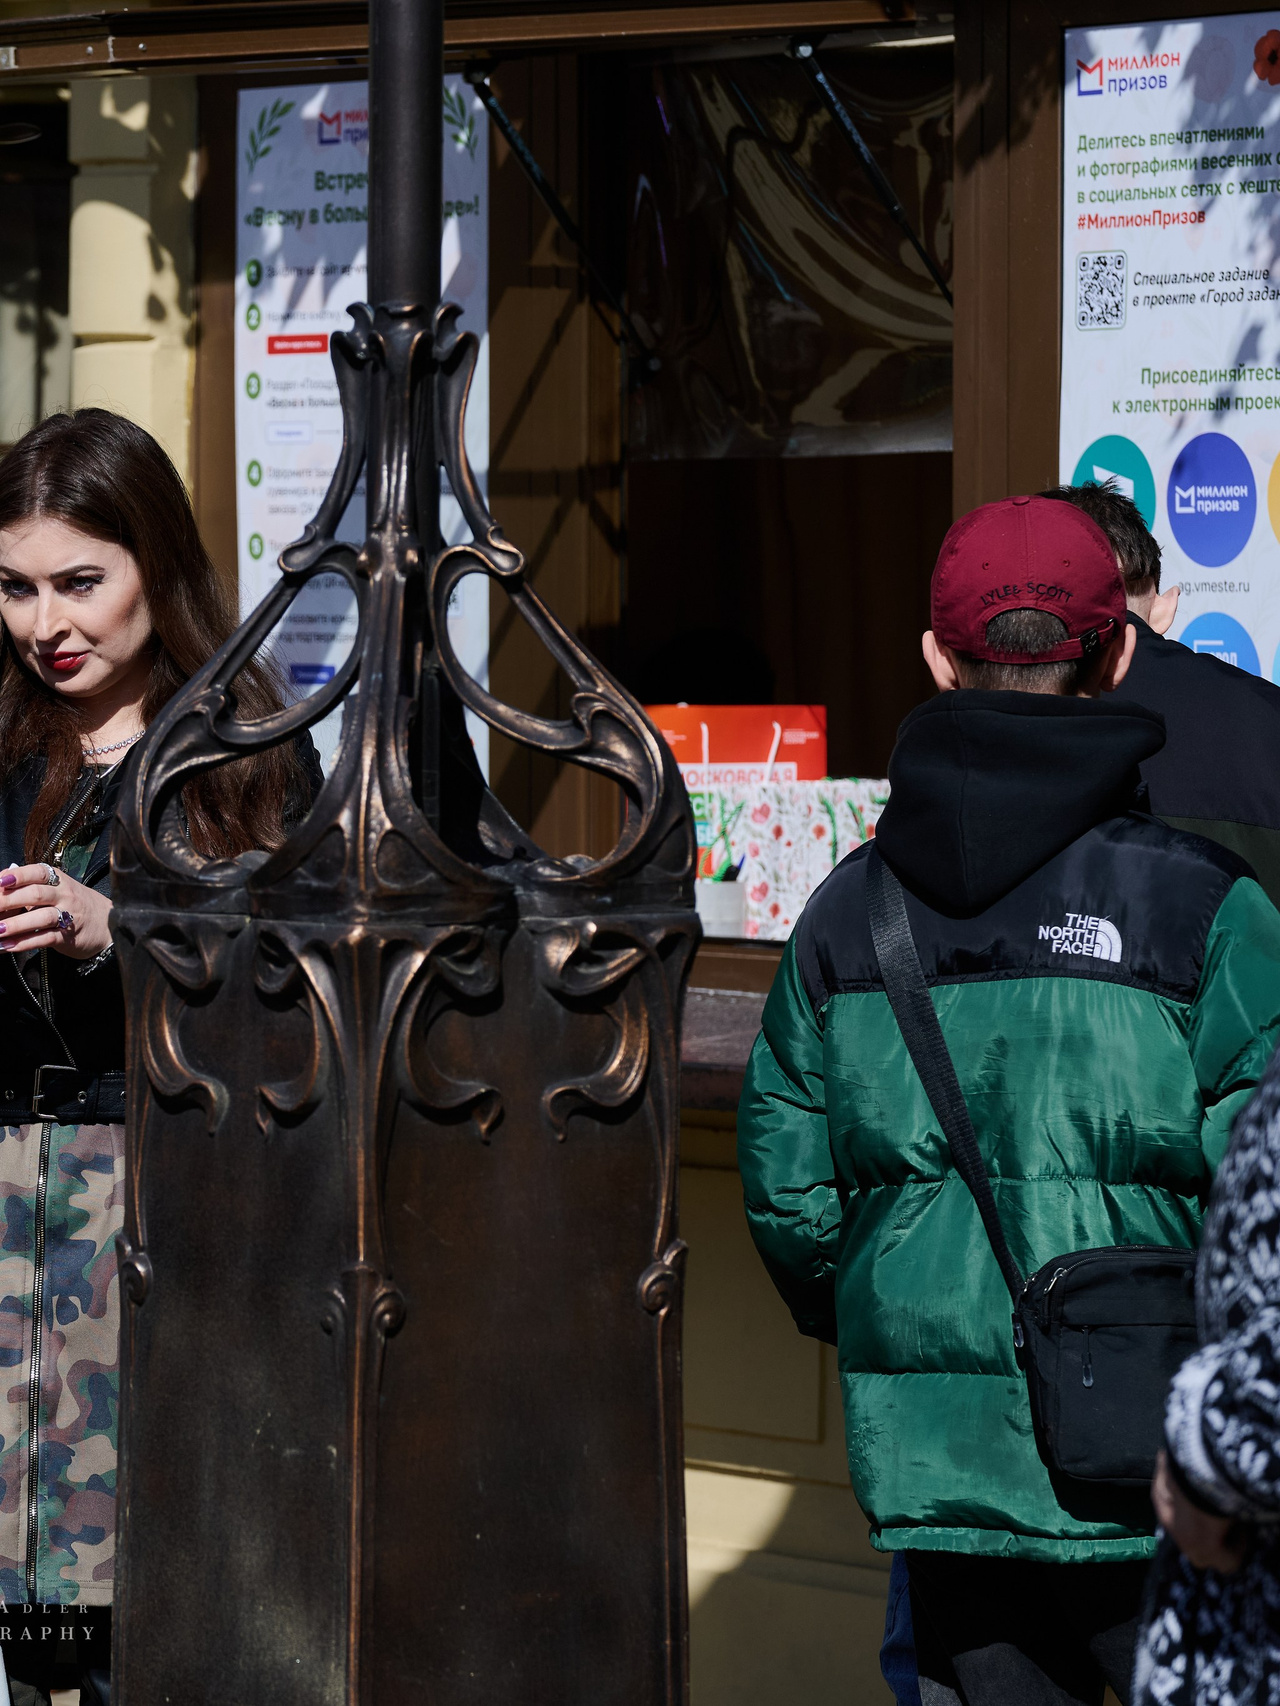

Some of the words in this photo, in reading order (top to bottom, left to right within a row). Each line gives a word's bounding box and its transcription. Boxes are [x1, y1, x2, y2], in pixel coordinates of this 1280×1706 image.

[1108, 75, 1167, 96] призов
[1077, 134, 1146, 153] Делитесь
[1150, 126, 1265, 147] впечатлениями
[1077, 164, 1086, 178] и
[1090, 155, 1197, 180] фотографиями
[1201, 152, 1272, 170] весенних
[315, 170, 368, 195] Встре
[1077, 190, 1085, 203] в
[1089, 184, 1176, 204] социальных
[1181, 183, 1221, 197] сетях
[1226, 182, 1234, 195] с
[1077, 210, 1206, 230] #МиллионПризов
[1133, 271, 1215, 288] Специальное
[1218, 266, 1270, 282] задание
[1133, 296, 1139, 306] в
[1143, 292, 1196, 309] проекте
[1200, 287, 1245, 306] «Город
[1112, 400, 1120, 413] к
[1125, 396, 1231, 416] электронным
[1235, 395, 1280, 415] проек
[1196, 500, 1240, 515] призов
[980, 584, 1012, 606] LYLE
[1026, 581, 1074, 604] SCOTT
[1065, 912, 1100, 930] THE
[1038, 925, 1096, 944] NORTH
[1051, 939, 1094, 957] FACE
